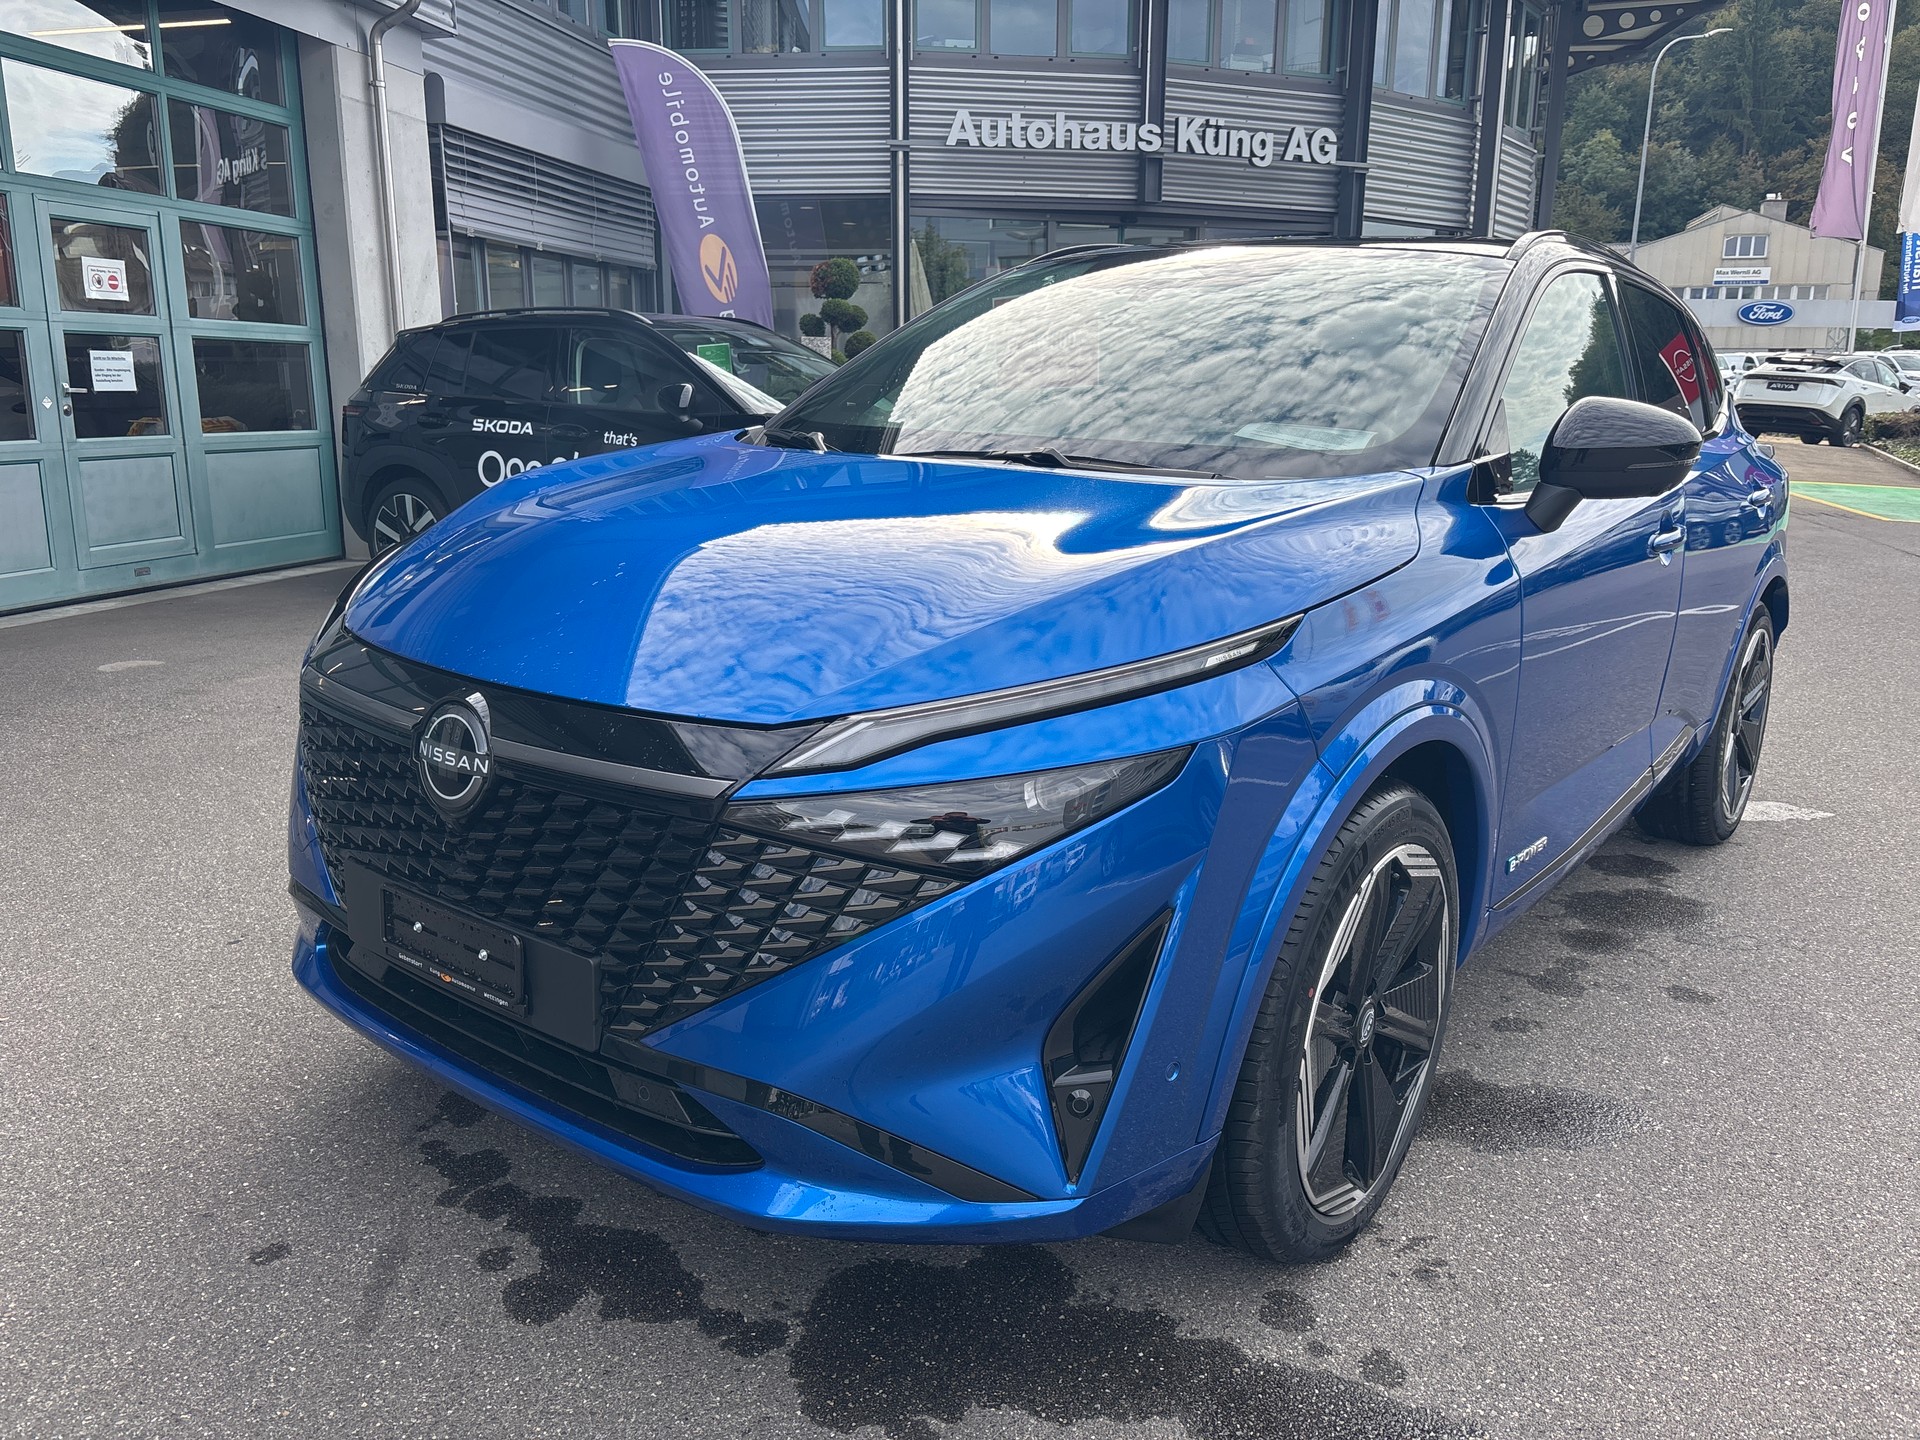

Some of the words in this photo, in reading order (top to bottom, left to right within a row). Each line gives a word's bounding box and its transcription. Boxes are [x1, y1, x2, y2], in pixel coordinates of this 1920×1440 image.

[945, 108, 1162, 152] Autohaus
[1176, 115, 1275, 168] Küng
[1284, 126, 1338, 164] AG
[1749, 304, 1785, 320] Ford
[603, 431, 638, 447] that's
[419, 740, 489, 774] NISSAN
